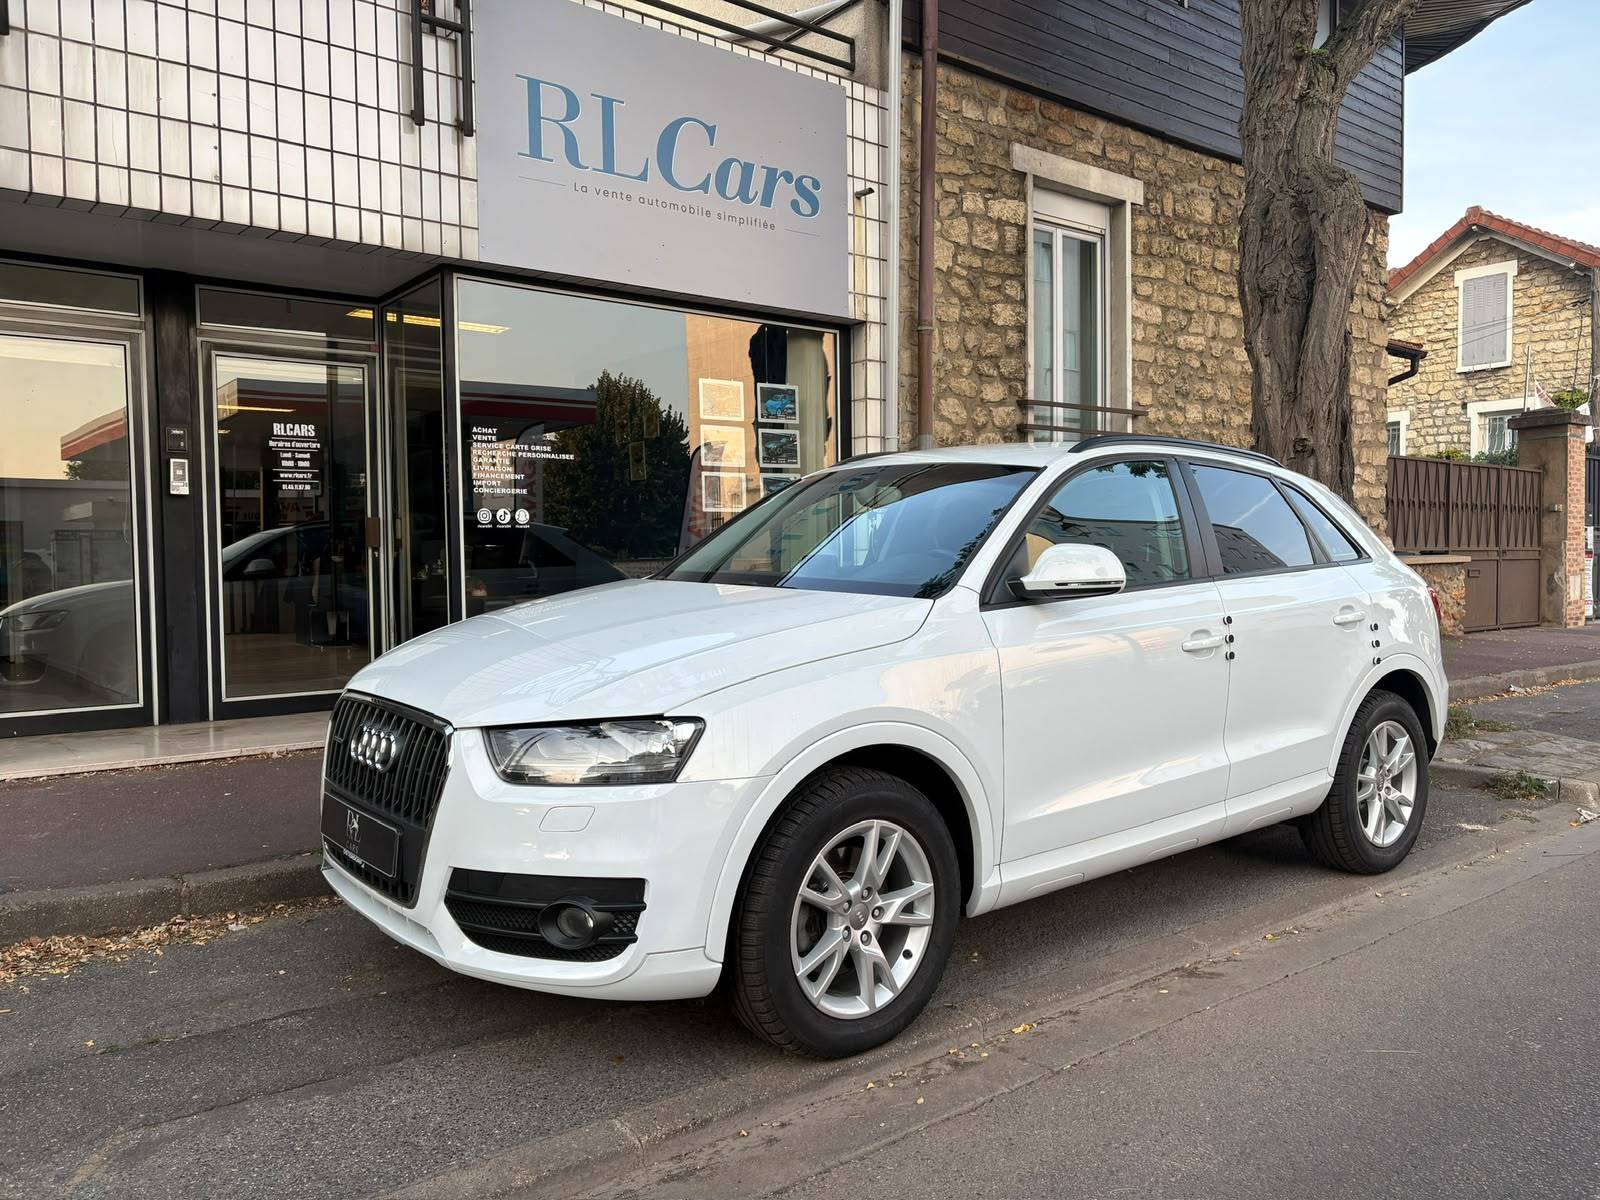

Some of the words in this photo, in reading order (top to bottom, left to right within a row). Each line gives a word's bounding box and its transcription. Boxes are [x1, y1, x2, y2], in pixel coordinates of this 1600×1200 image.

[515, 73, 823, 219] RLCars
[573, 181, 589, 194] La
[594, 187, 633, 202] vente
[638, 195, 712, 218] automobile
[716, 209, 777, 231] simplifiée
[273, 422, 316, 437] RLCARS
[472, 426, 498, 434] ACHAT
[472, 434, 497, 442] VENTE
[269, 440, 291, 448] Horaires
[292, 441, 321, 449] d'ouverture
[473, 450, 517, 458] RECHERCHE
[518, 452, 575, 460] PERSONNALISEE
[473, 457, 511, 465] GARANTIE
[473, 487, 528, 495] CONCIERGERIE
